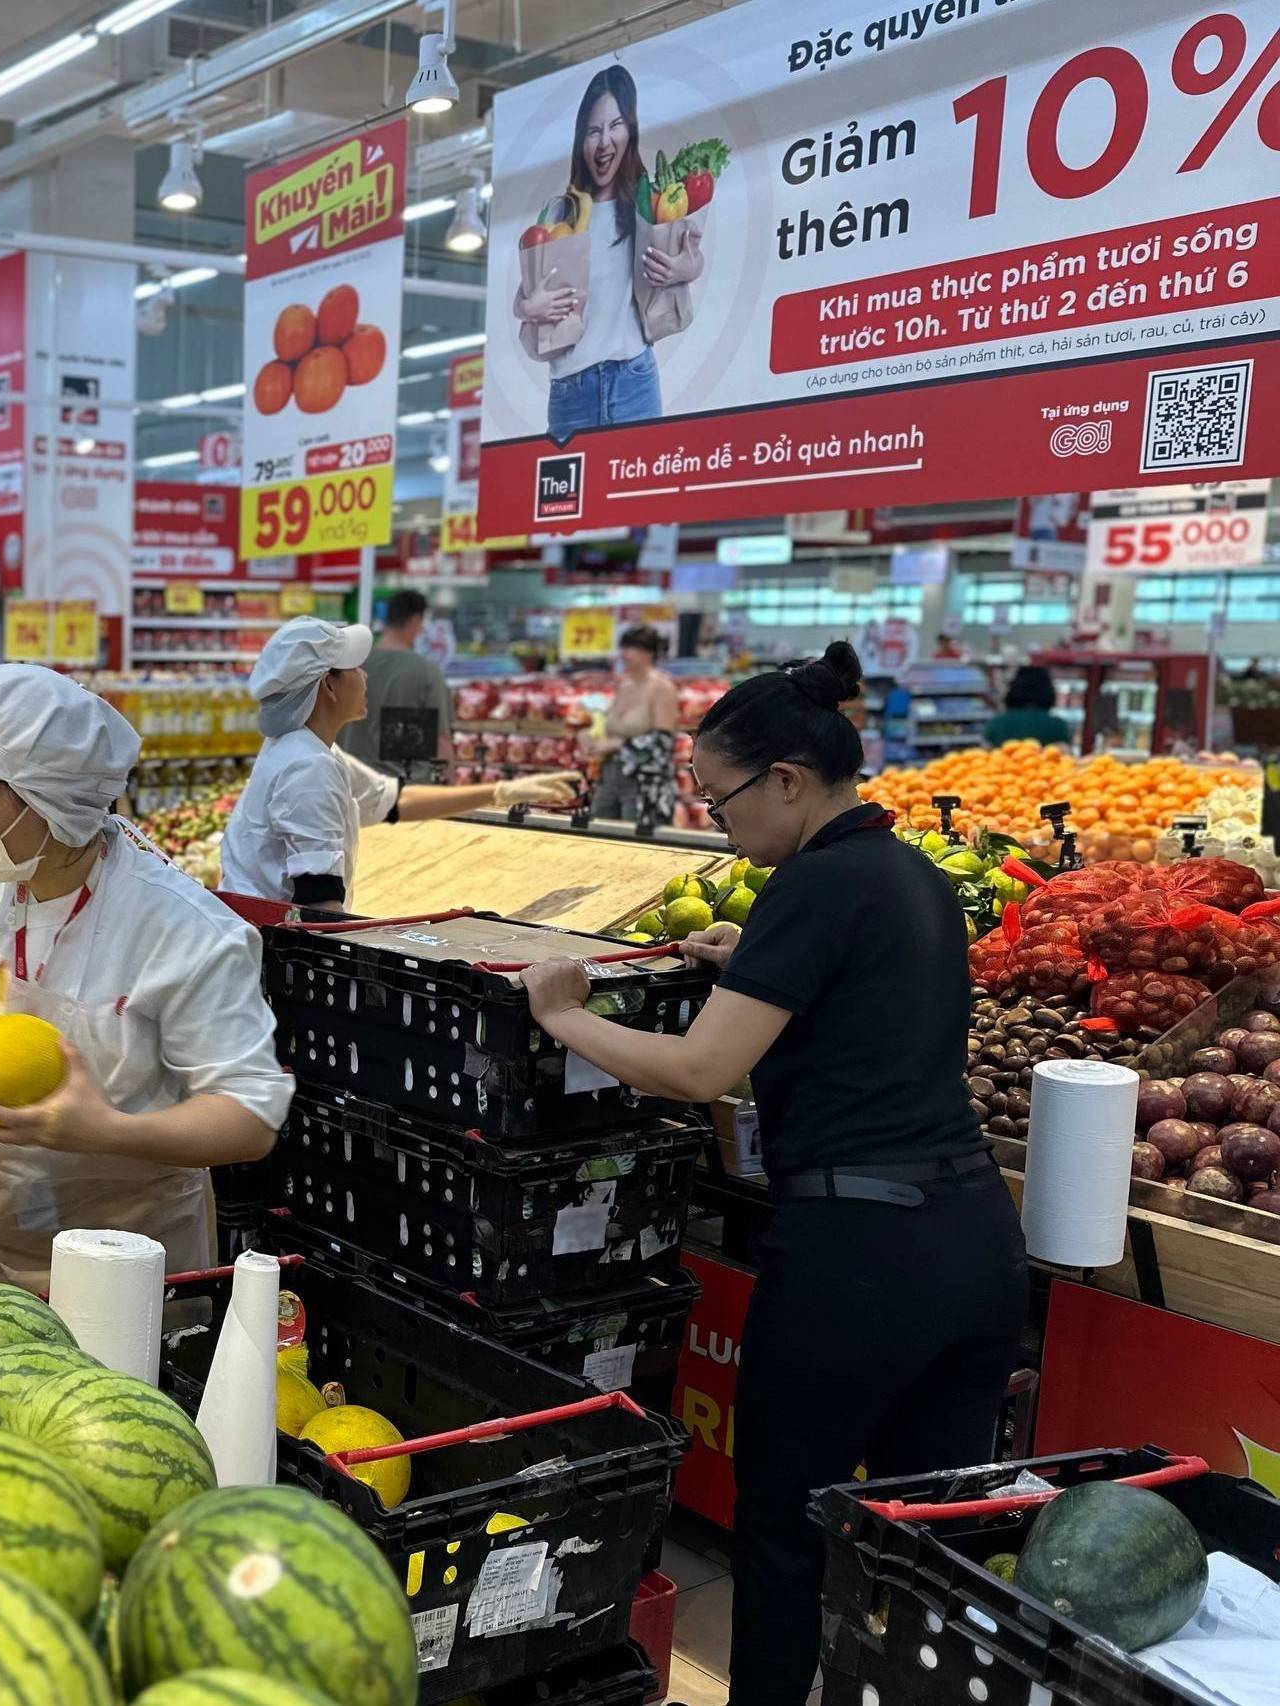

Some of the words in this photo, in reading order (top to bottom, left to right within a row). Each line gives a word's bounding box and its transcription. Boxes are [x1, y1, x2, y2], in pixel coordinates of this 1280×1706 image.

[788, 28, 853, 72] Đặc
[952, 13, 1280, 220] 10%
[781, 118, 916, 186] Giảm
[260, 157, 354, 230] Khuyến
[776, 195, 910, 261] thêm
[820, 293, 859, 322] Khi
[867, 286, 922, 312] mua
[930, 271, 993, 301] thực
[1001, 251, 1086, 293] phẩm
[1097, 234, 1162, 271] tươi
[1172, 221, 1259, 257] sống
[820, 324, 886, 355] trước
[894, 316, 948, 343] 10h.
[958, 306, 992, 332] Từ
[1000, 295, 1051, 325] thứ
[1057, 290, 1077, 317] 2
[1087, 279, 1148, 311] đến
[1159, 267, 1218, 299] thứ
[1227, 260, 1249, 289] 6
[830, 370, 858, 386] dụng
[861, 365, 883, 380] cho
[886, 361, 913, 376] toàn
[916, 355, 932, 373] bộ
[935, 355, 956, 370] sản
[959, 348, 996, 367] phẩm
[1052, 334, 1072, 351] hải
[1075, 334, 1100, 348] sản
[1140, 325, 1168, 340] rau,
[1200, 311, 1226, 330] trái
[1230, 308, 1266, 326] cây)
[1041, 406, 1062, 421] Tại
[1063, 402, 1090, 418] ứng
[1093, 399, 1130, 416] dụng
[1050, 420, 1112, 457] GO!
[608, 453, 646, 481] Tích
[653, 446, 701, 476] điểm
[707, 441, 732, 470] dễ
[753, 435, 792, 466] Đổi
[798, 433, 841, 467] quà
[849, 424, 924, 456] nhanh
[254, 477, 376, 549] 59.000
[542, 502, 576, 514] Vietnam
[1104, 519, 1250, 568] 55.000
